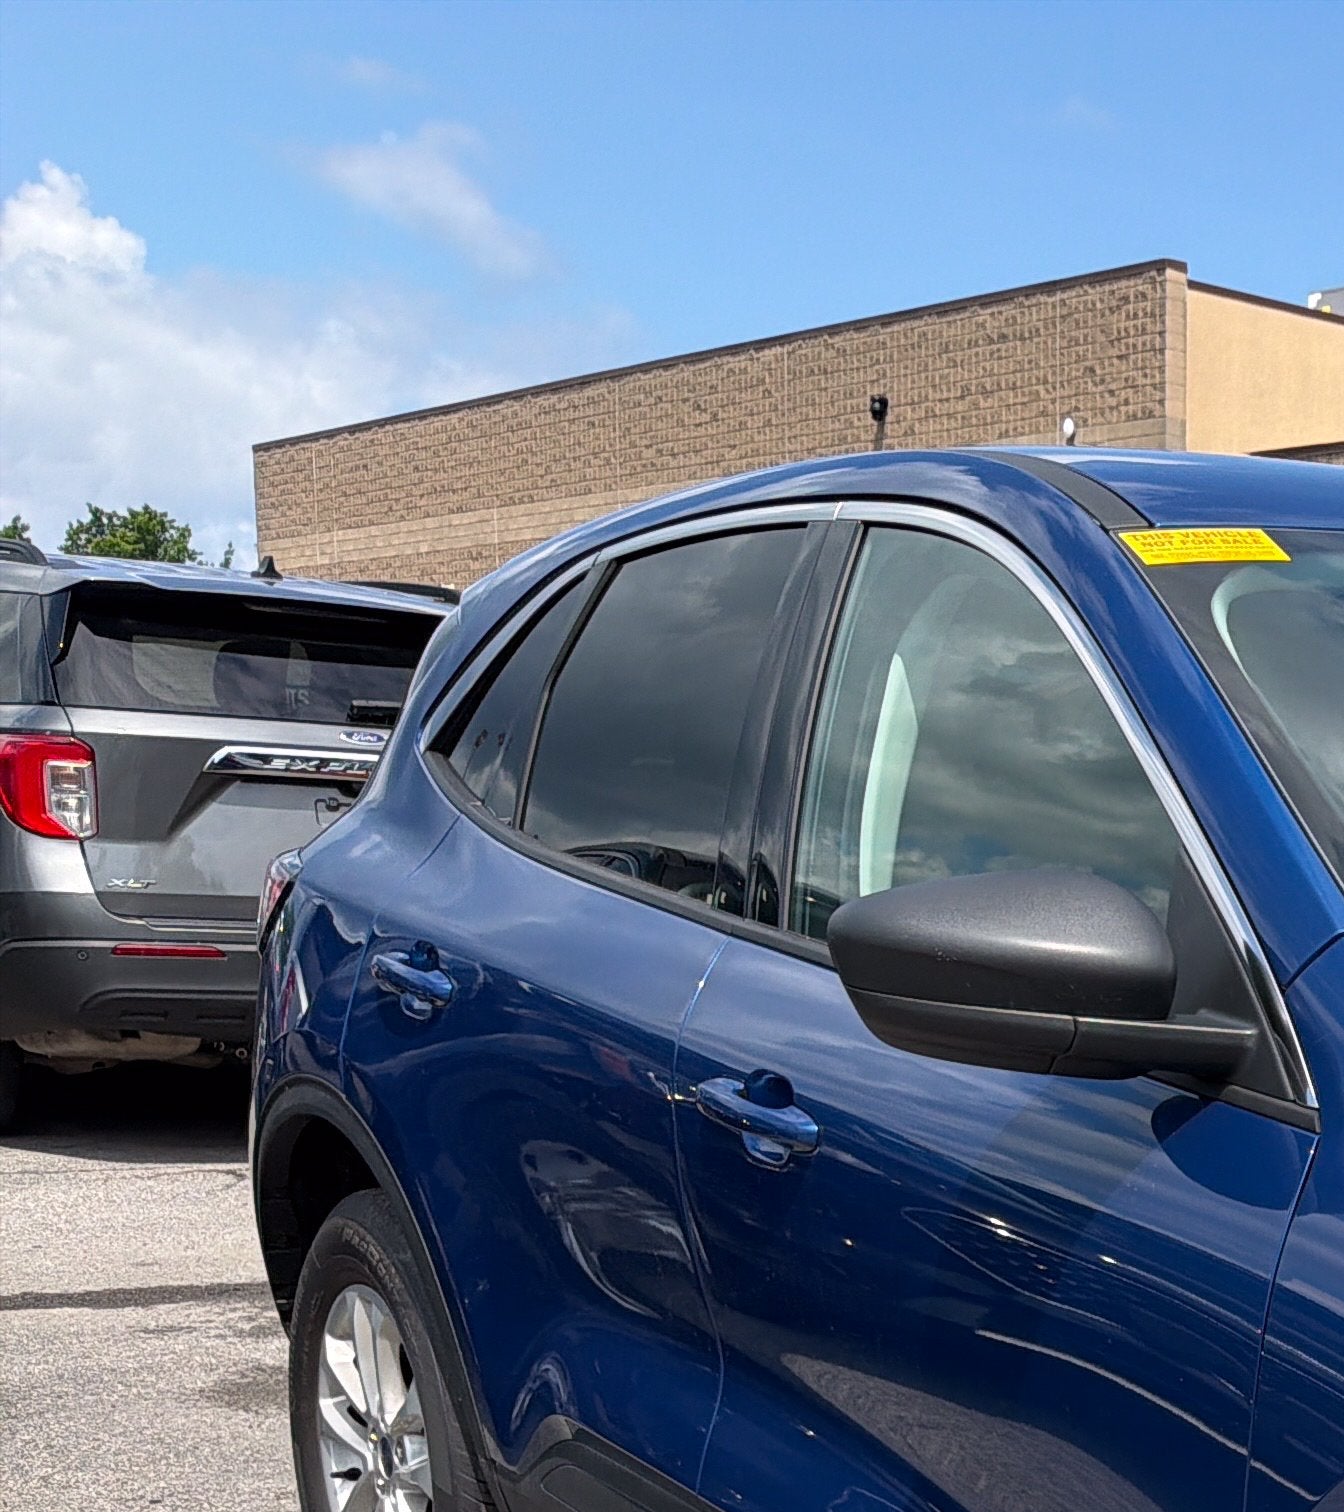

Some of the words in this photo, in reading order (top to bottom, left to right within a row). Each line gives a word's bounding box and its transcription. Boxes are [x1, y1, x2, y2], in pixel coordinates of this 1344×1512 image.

[1129, 532, 1176, 541] THIS
[1179, 530, 1262, 540] VEHICLE
[1140, 539, 1175, 549] NOT
[1181, 538, 1215, 547] FOR
[1221, 538, 1266, 546] SALE
[261, 757, 373, 776] EXPL
[105, 878, 157, 888] XLT
